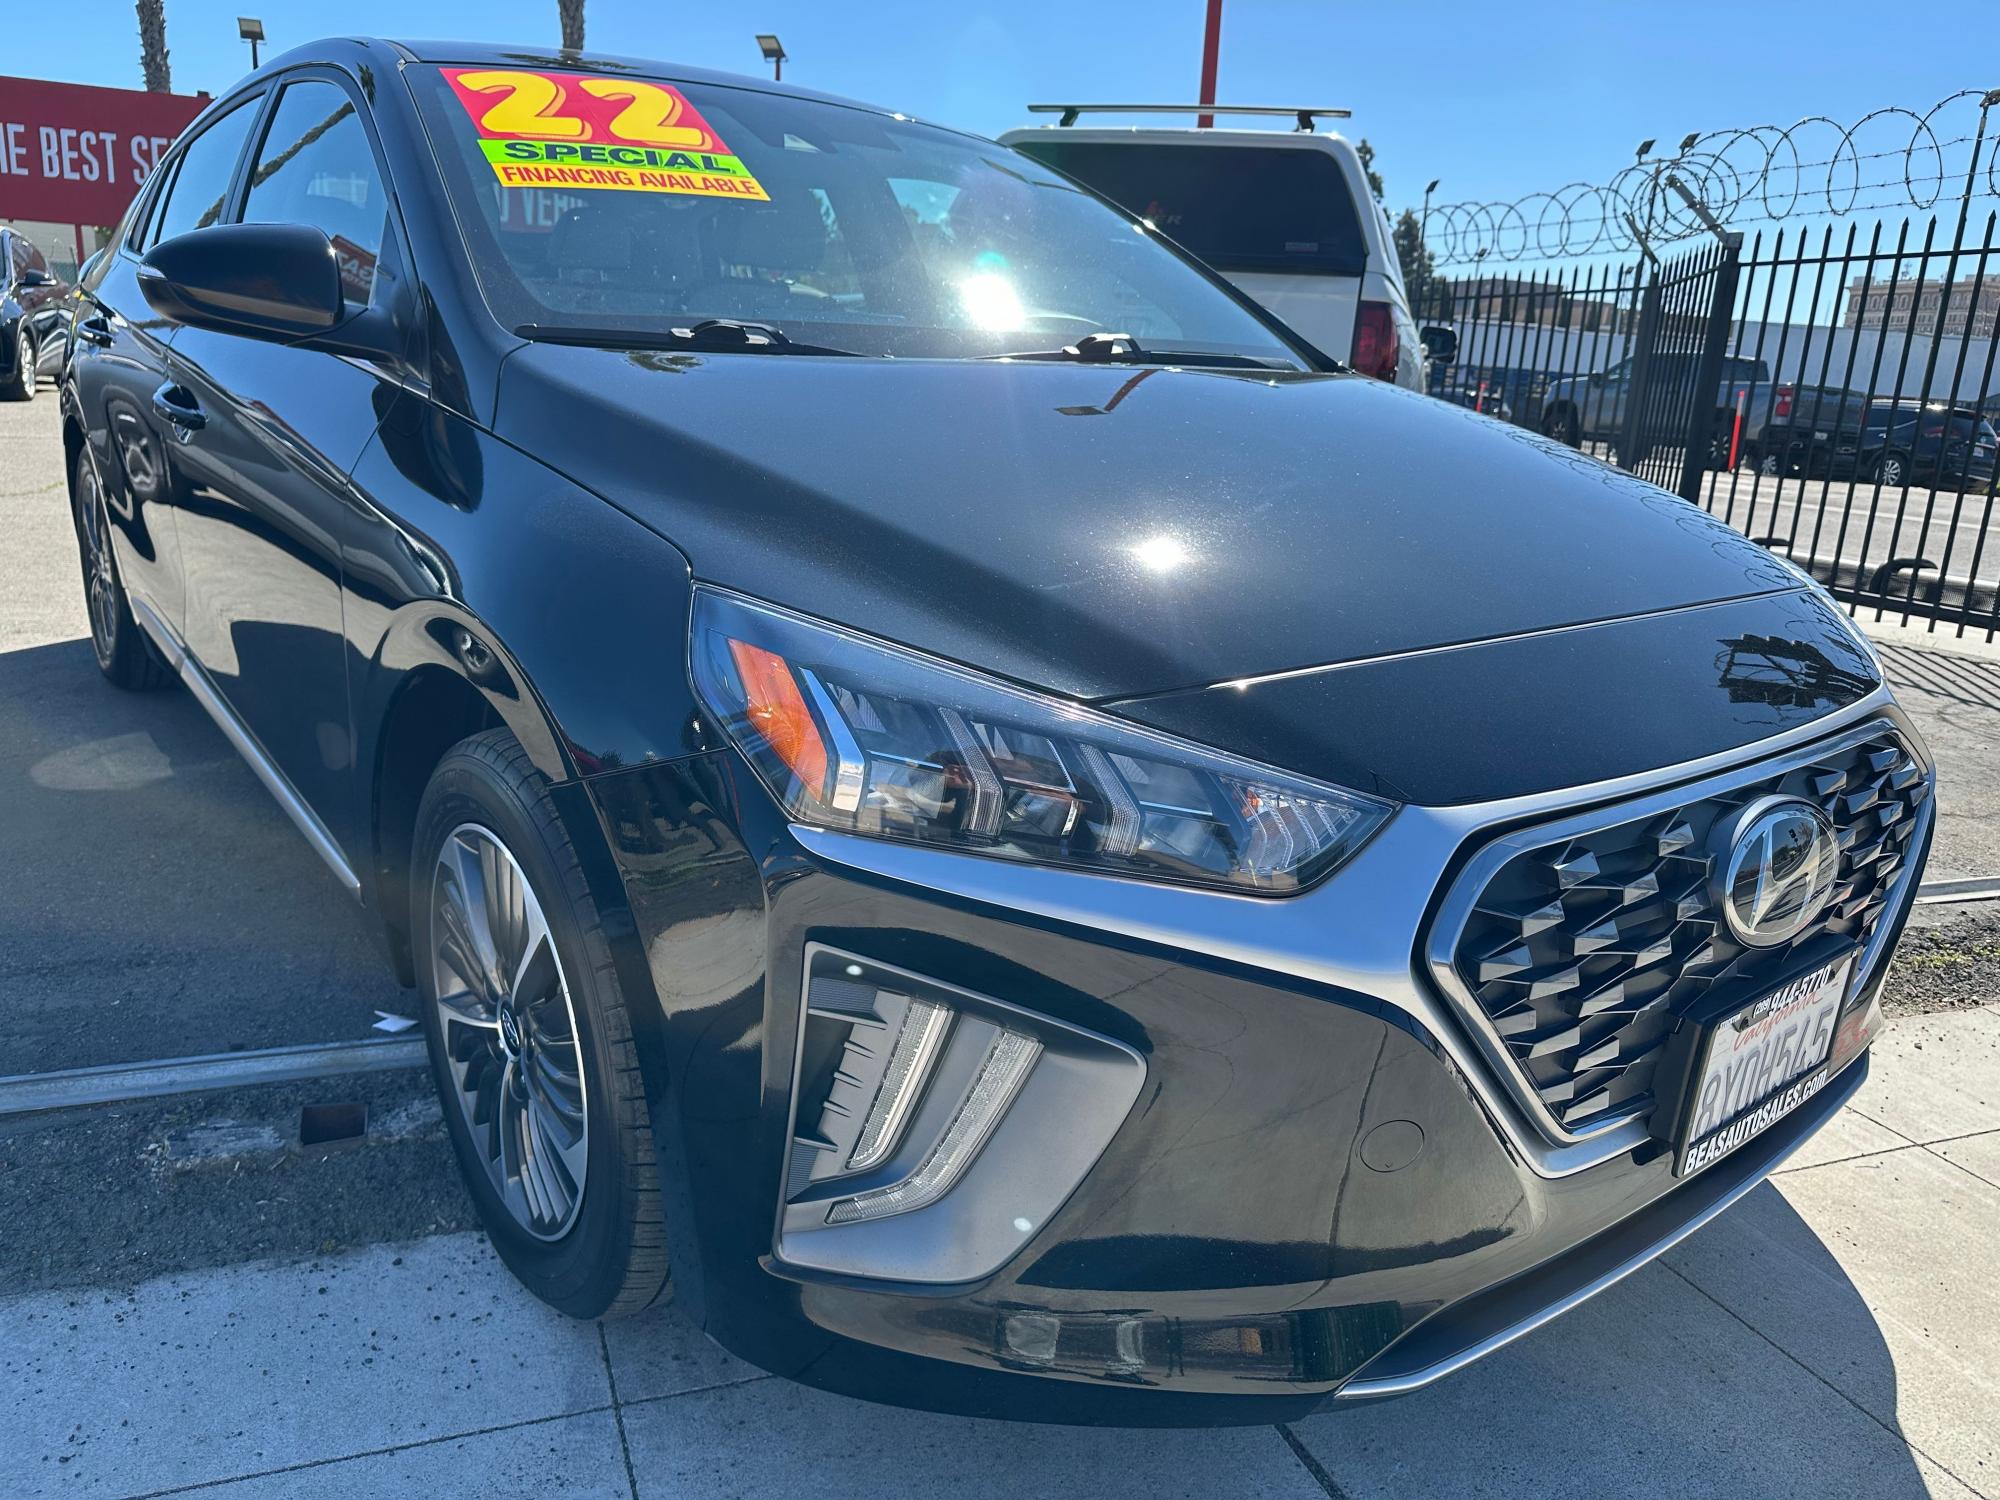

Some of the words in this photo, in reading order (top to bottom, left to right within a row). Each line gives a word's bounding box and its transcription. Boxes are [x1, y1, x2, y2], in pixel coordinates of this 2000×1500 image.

[456, 71, 712, 150] 22
[39, 126, 117, 184] BEST
[131, 135, 176, 186] SE
[502, 166, 634, 186] FINANCING
[640, 173, 760, 195] AVAILABLE
[504, 142, 733, 173] SPECIAL
[1769, 964, 1832, 1018] 944-5770
[1734, 991, 1823, 1051] California
